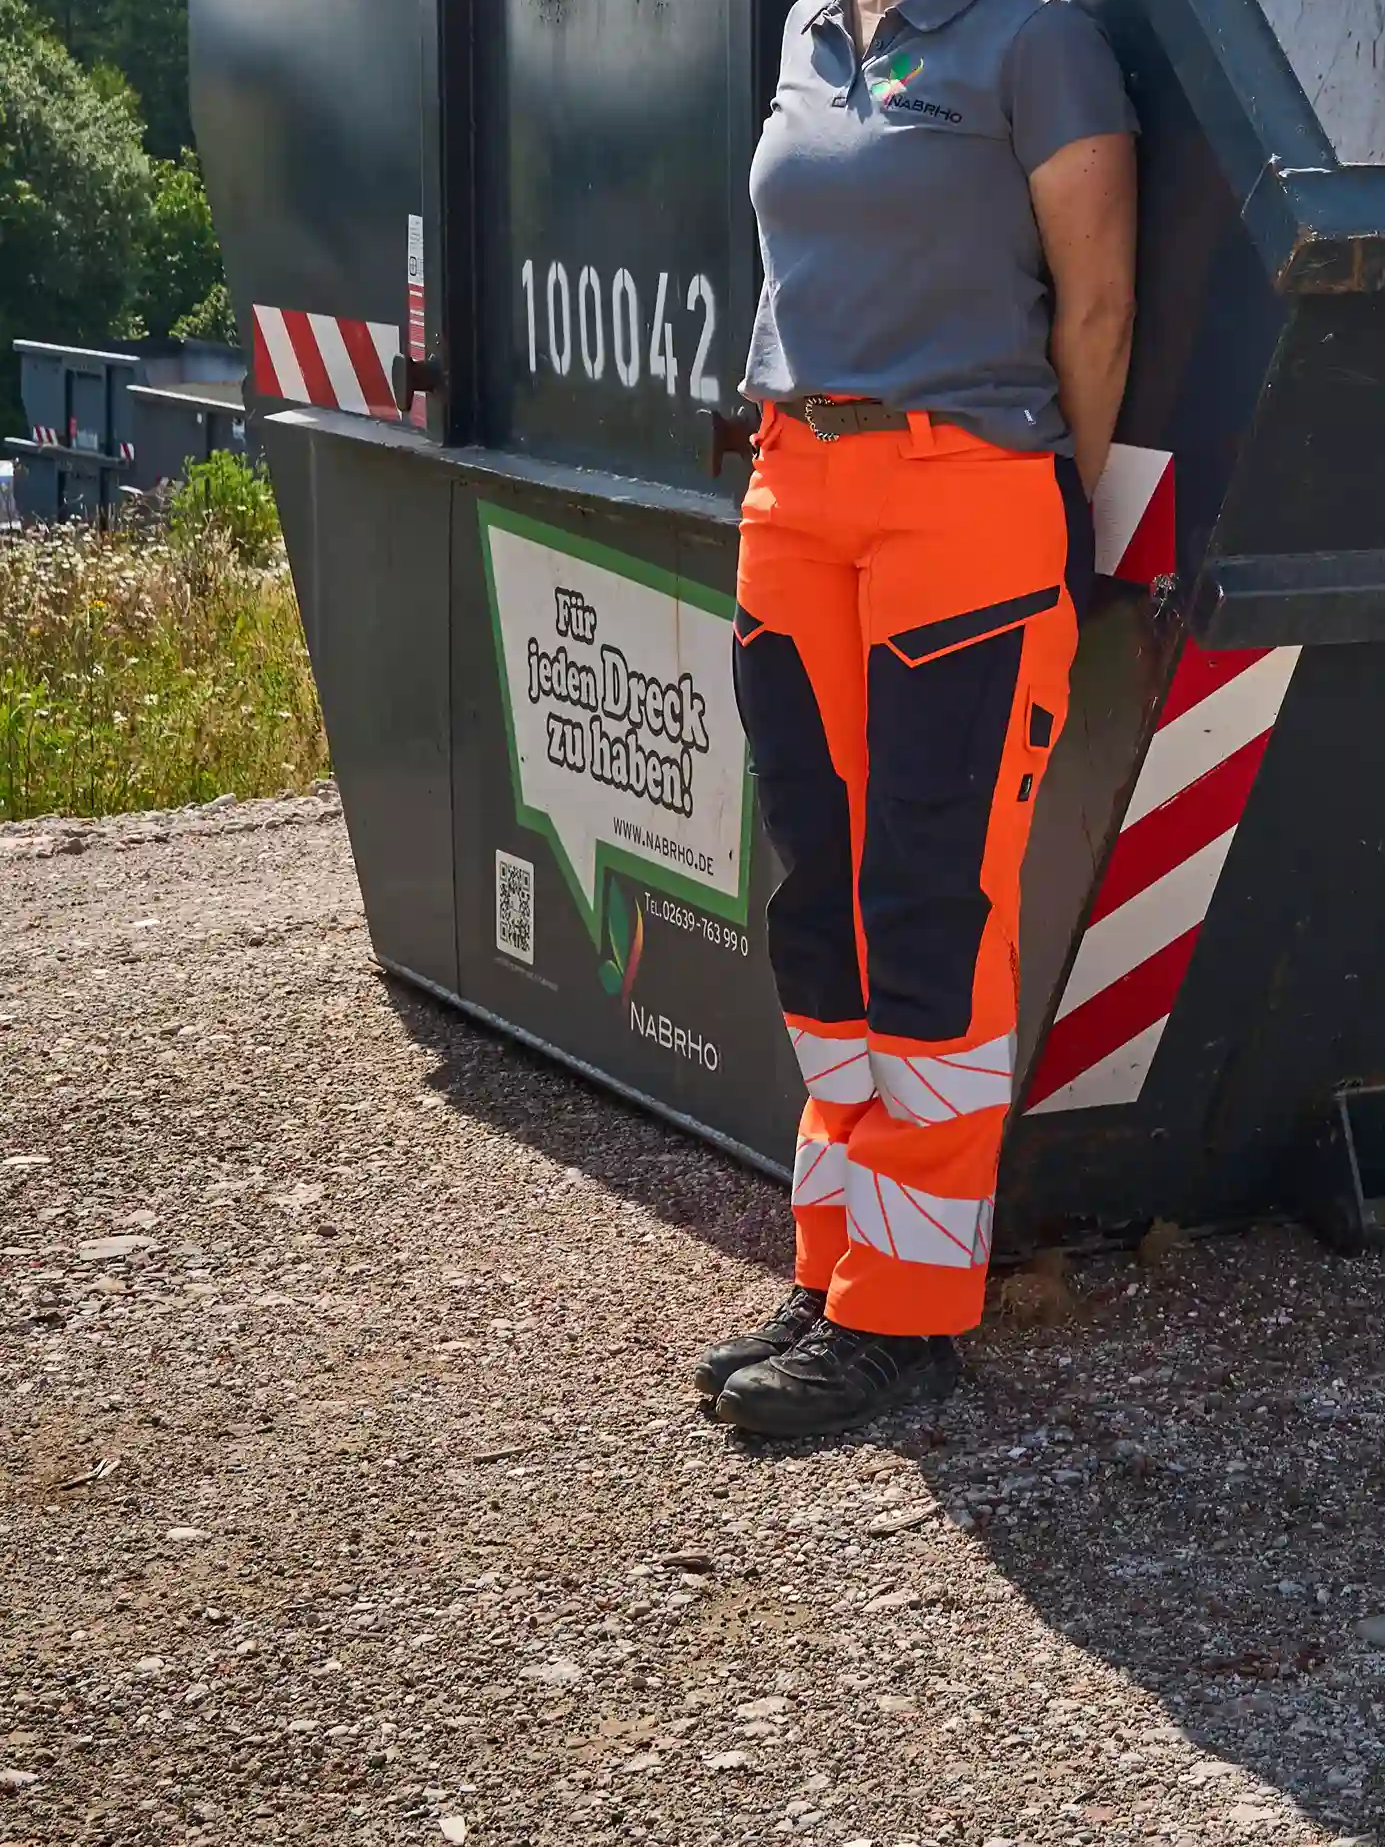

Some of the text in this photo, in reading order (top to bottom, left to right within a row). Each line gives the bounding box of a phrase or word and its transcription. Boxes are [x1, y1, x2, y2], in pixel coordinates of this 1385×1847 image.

[522, 259, 720, 403] 100042
[555, 587, 597, 645] Für
[528, 637, 709, 753] jeden Dreck
[547, 711, 693, 818] zu haben!
[613, 816, 714, 876] WWW.NABRHO.DE
[723, 928, 739, 951] 99
[740, 936, 749, 956] 0
